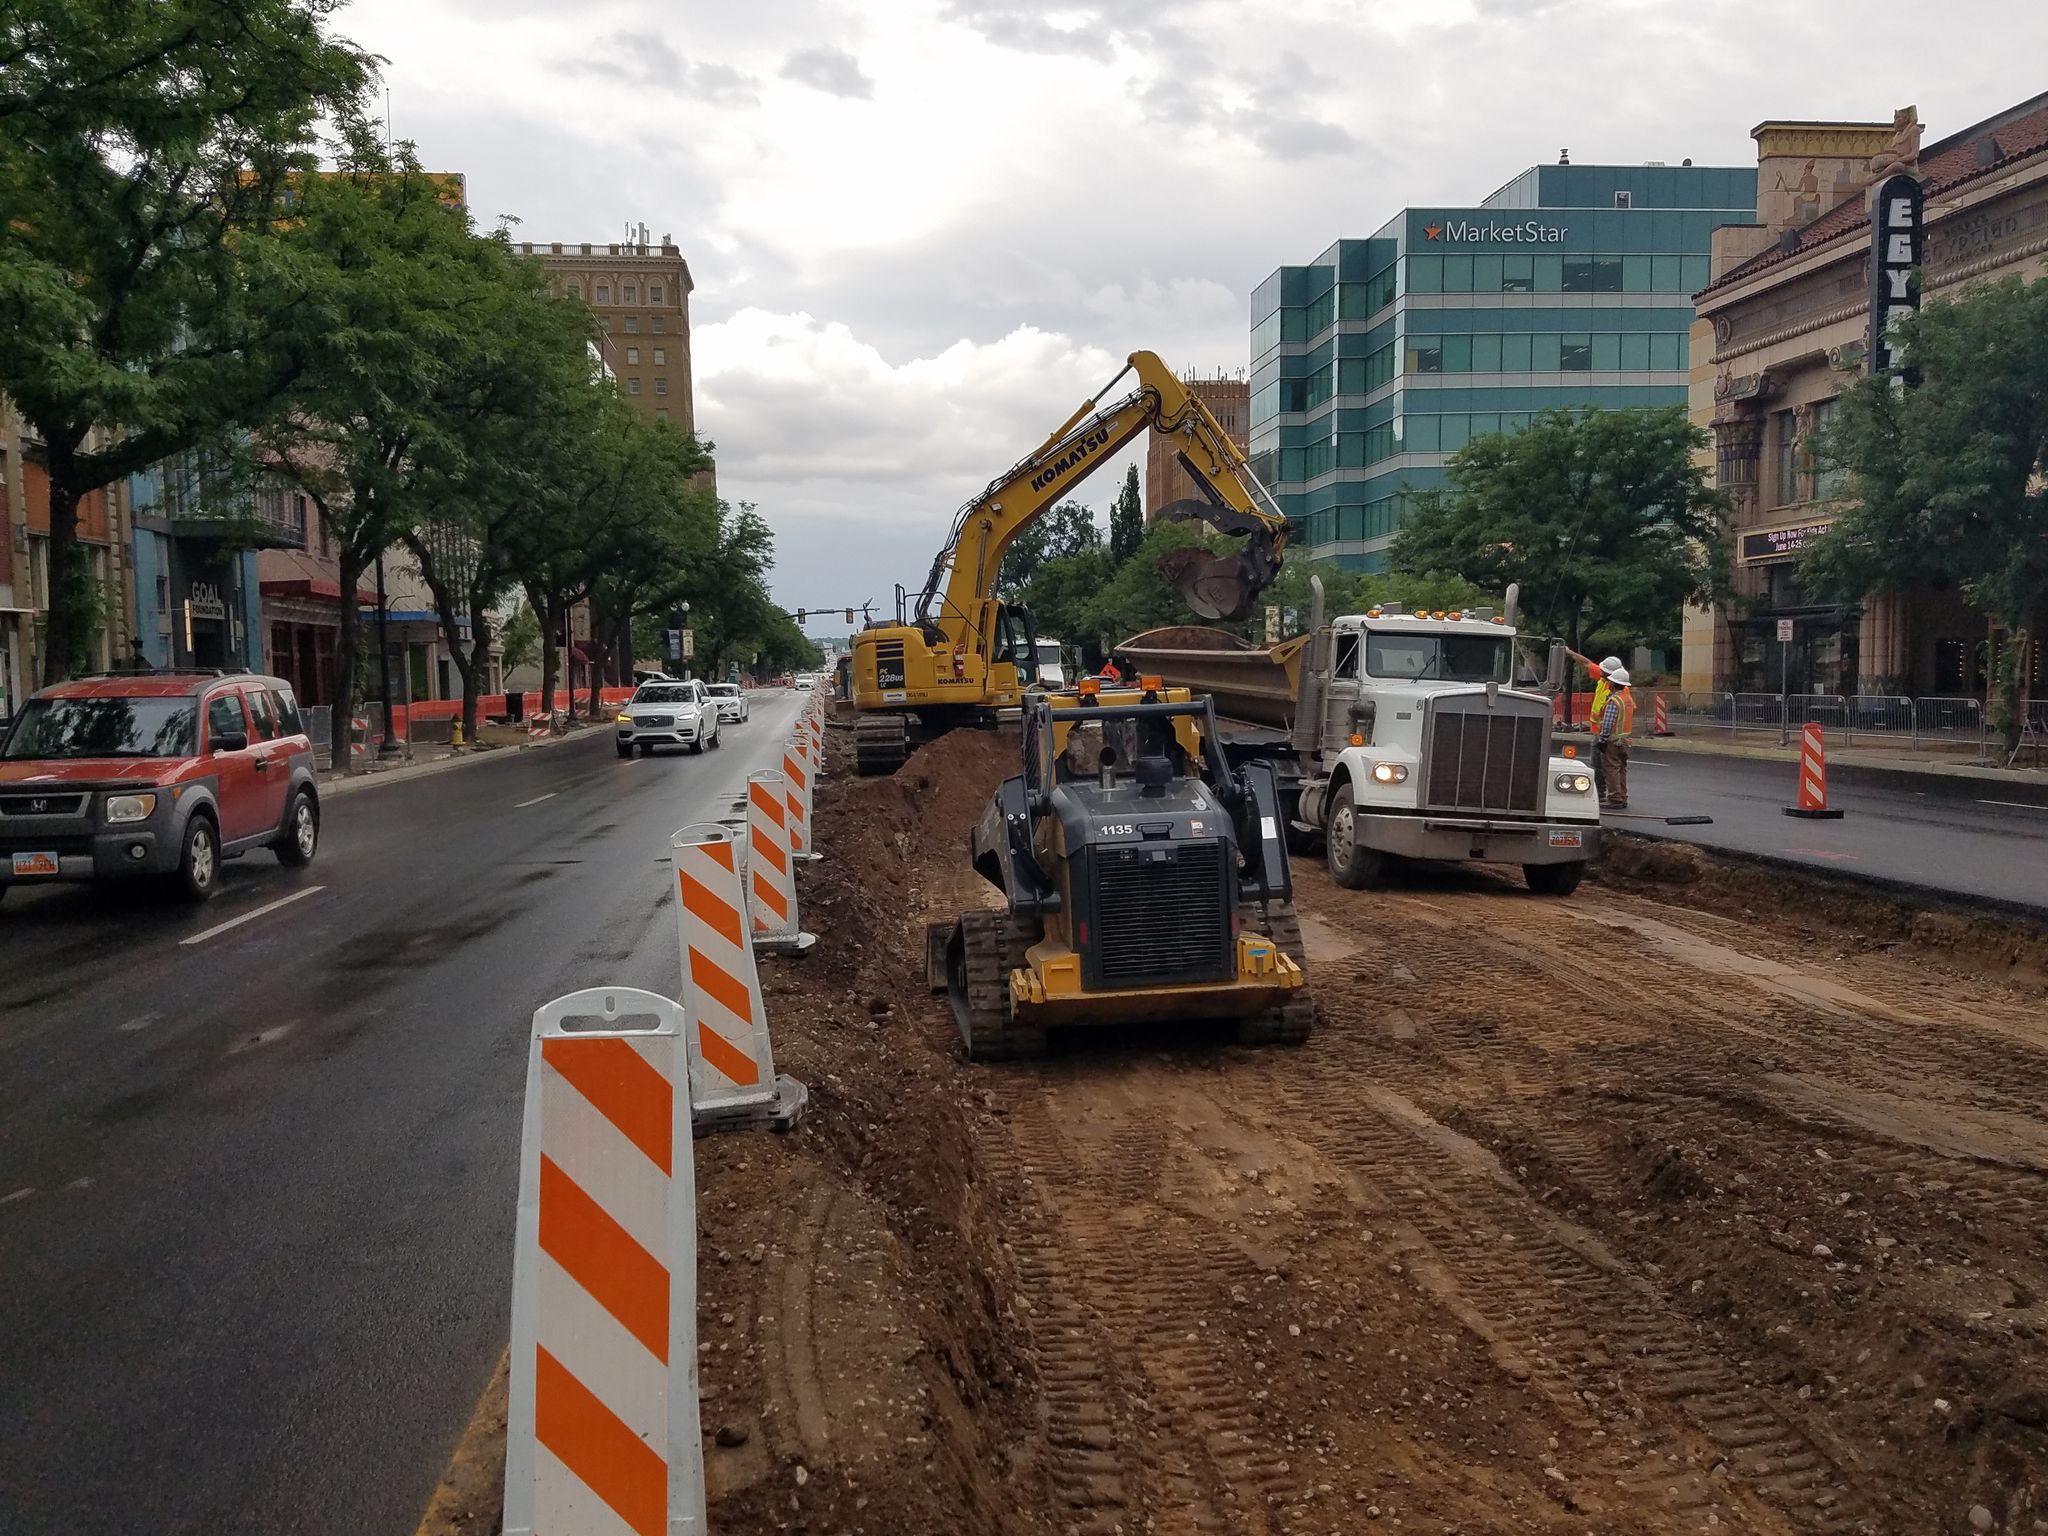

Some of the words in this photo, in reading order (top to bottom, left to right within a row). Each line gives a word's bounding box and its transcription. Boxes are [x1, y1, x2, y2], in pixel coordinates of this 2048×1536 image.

[1446, 220, 1568, 242] MarketStar
[1031, 427, 1110, 493] KOMATSU
[1767, 532, 1780, 543] Sign
[1780, 531, 1787, 541] Up
[1775, 543, 1787, 552] June
[192, 580, 221, 607] GOAL
[937, 676, 975, 685] KOMATSU
[1101, 824, 1133, 835] 1135
